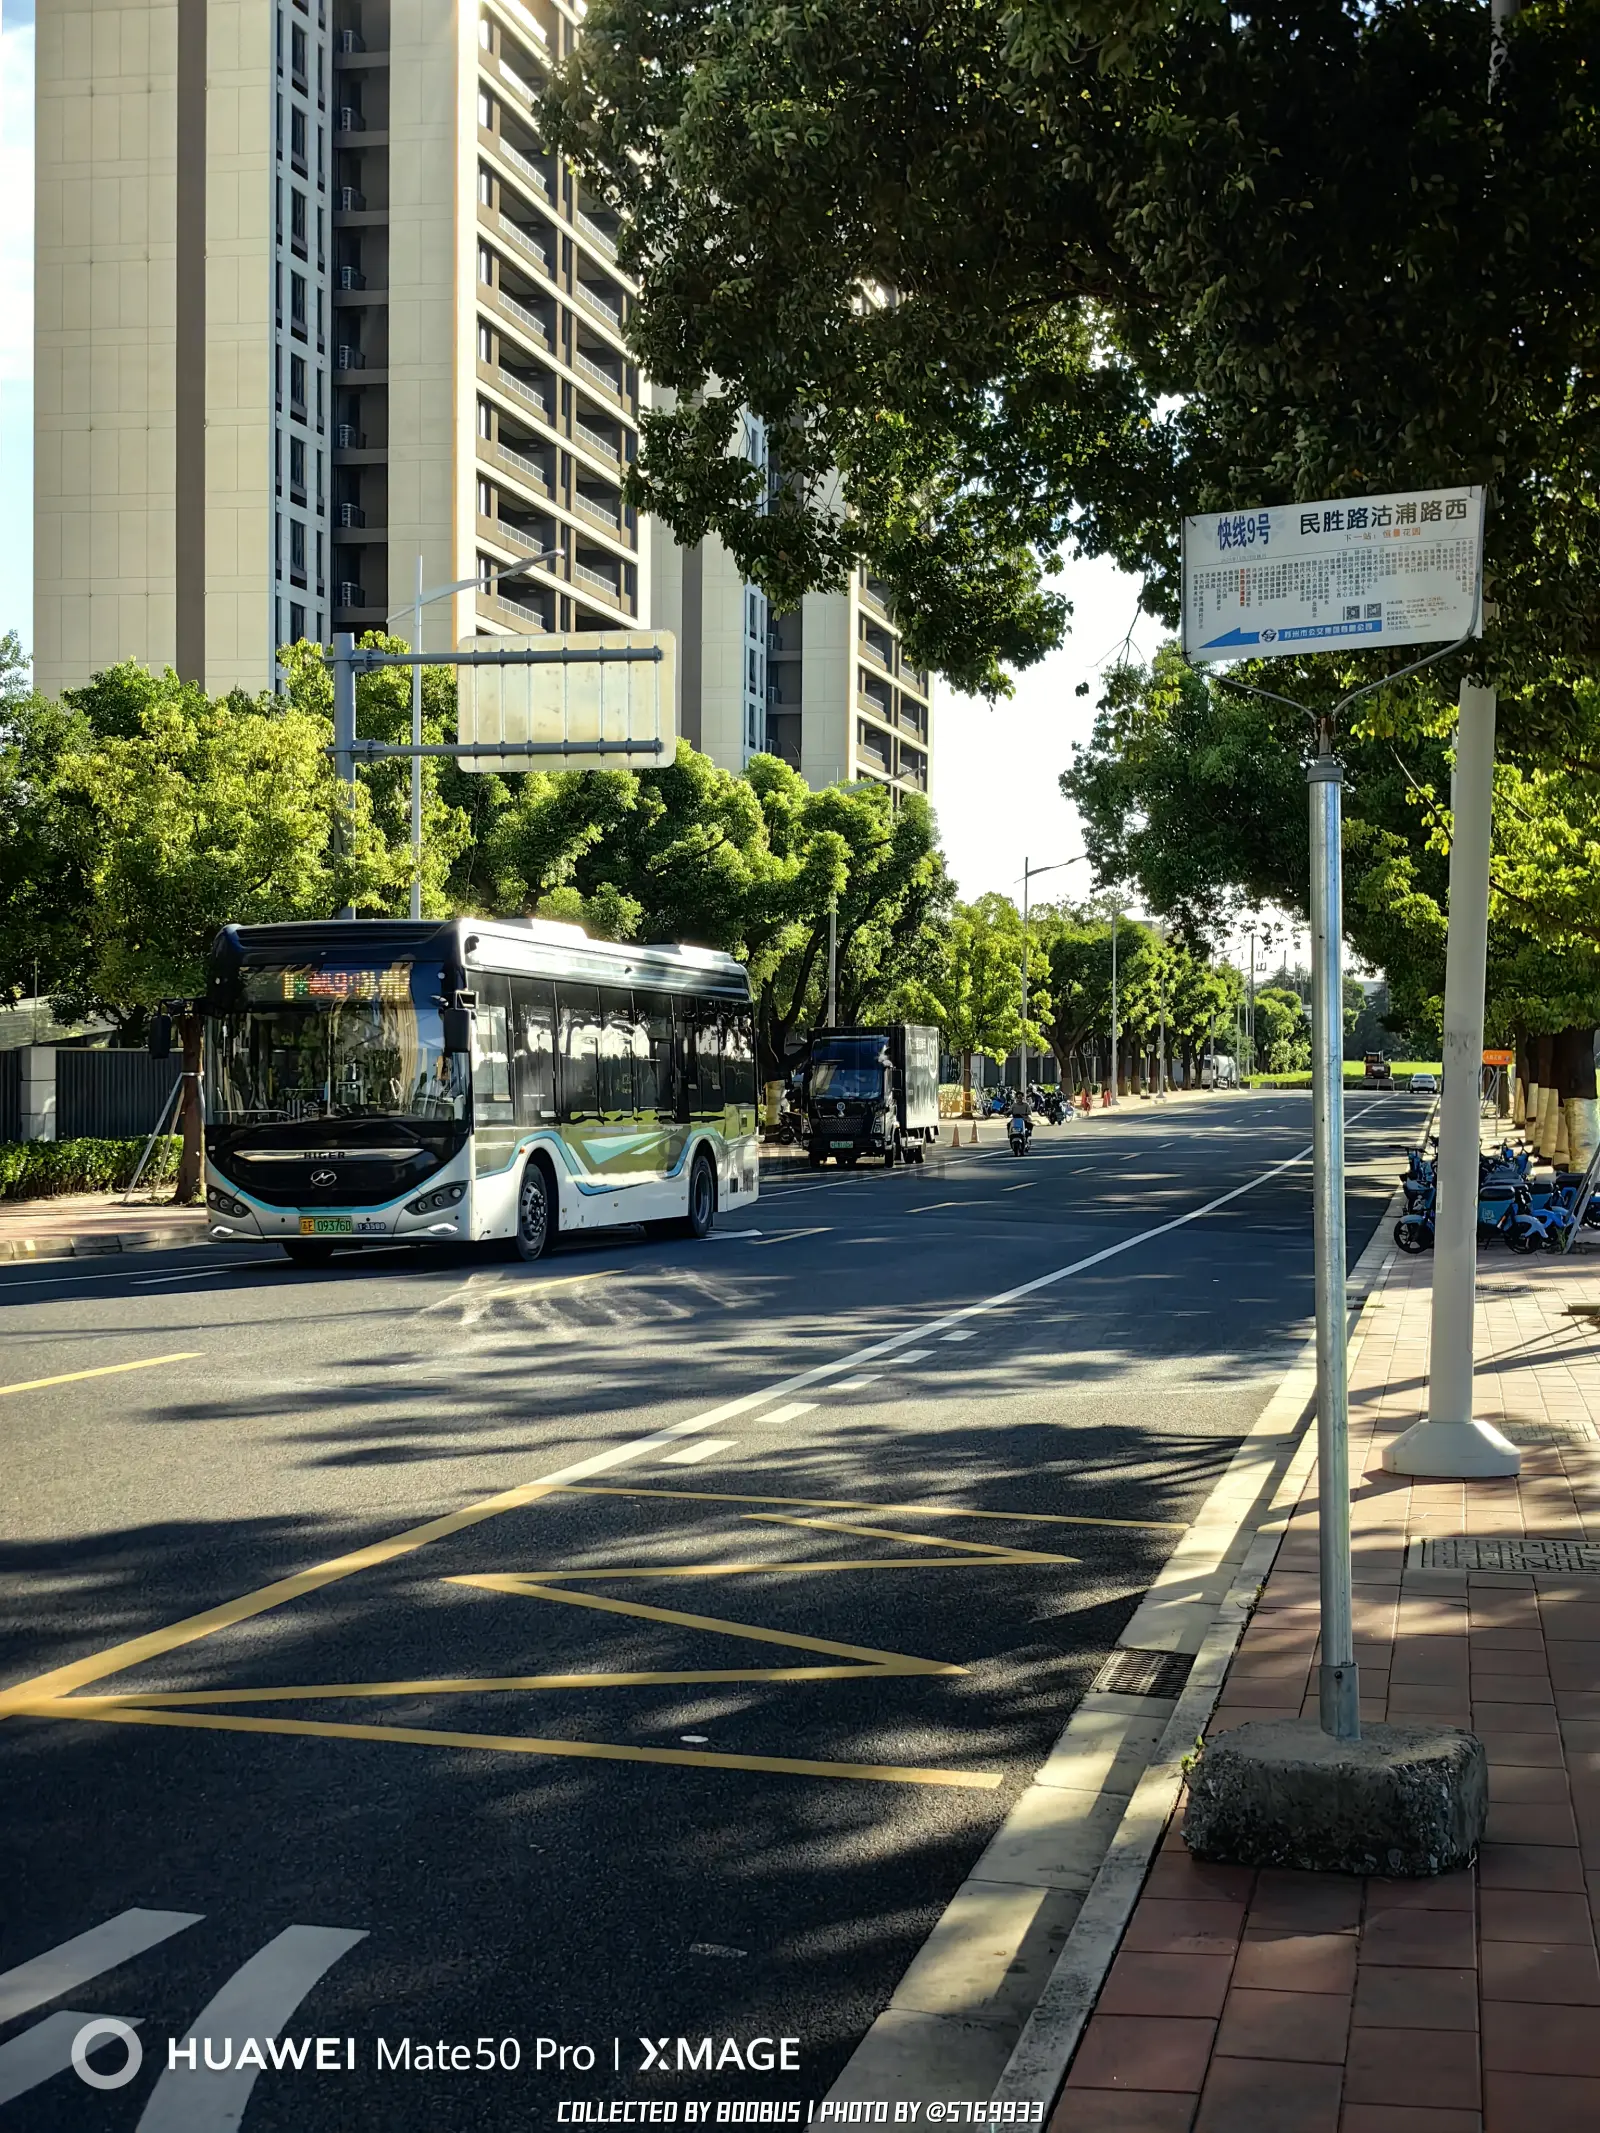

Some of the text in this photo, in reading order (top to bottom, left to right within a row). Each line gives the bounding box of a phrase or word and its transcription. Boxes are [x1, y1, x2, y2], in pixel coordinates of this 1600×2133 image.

[1217, 513, 1271, 551] 快线9号
[1300, 498, 1467, 535] 民胜路沽浦路西
[304, 1151, 346, 1160] HIGER
